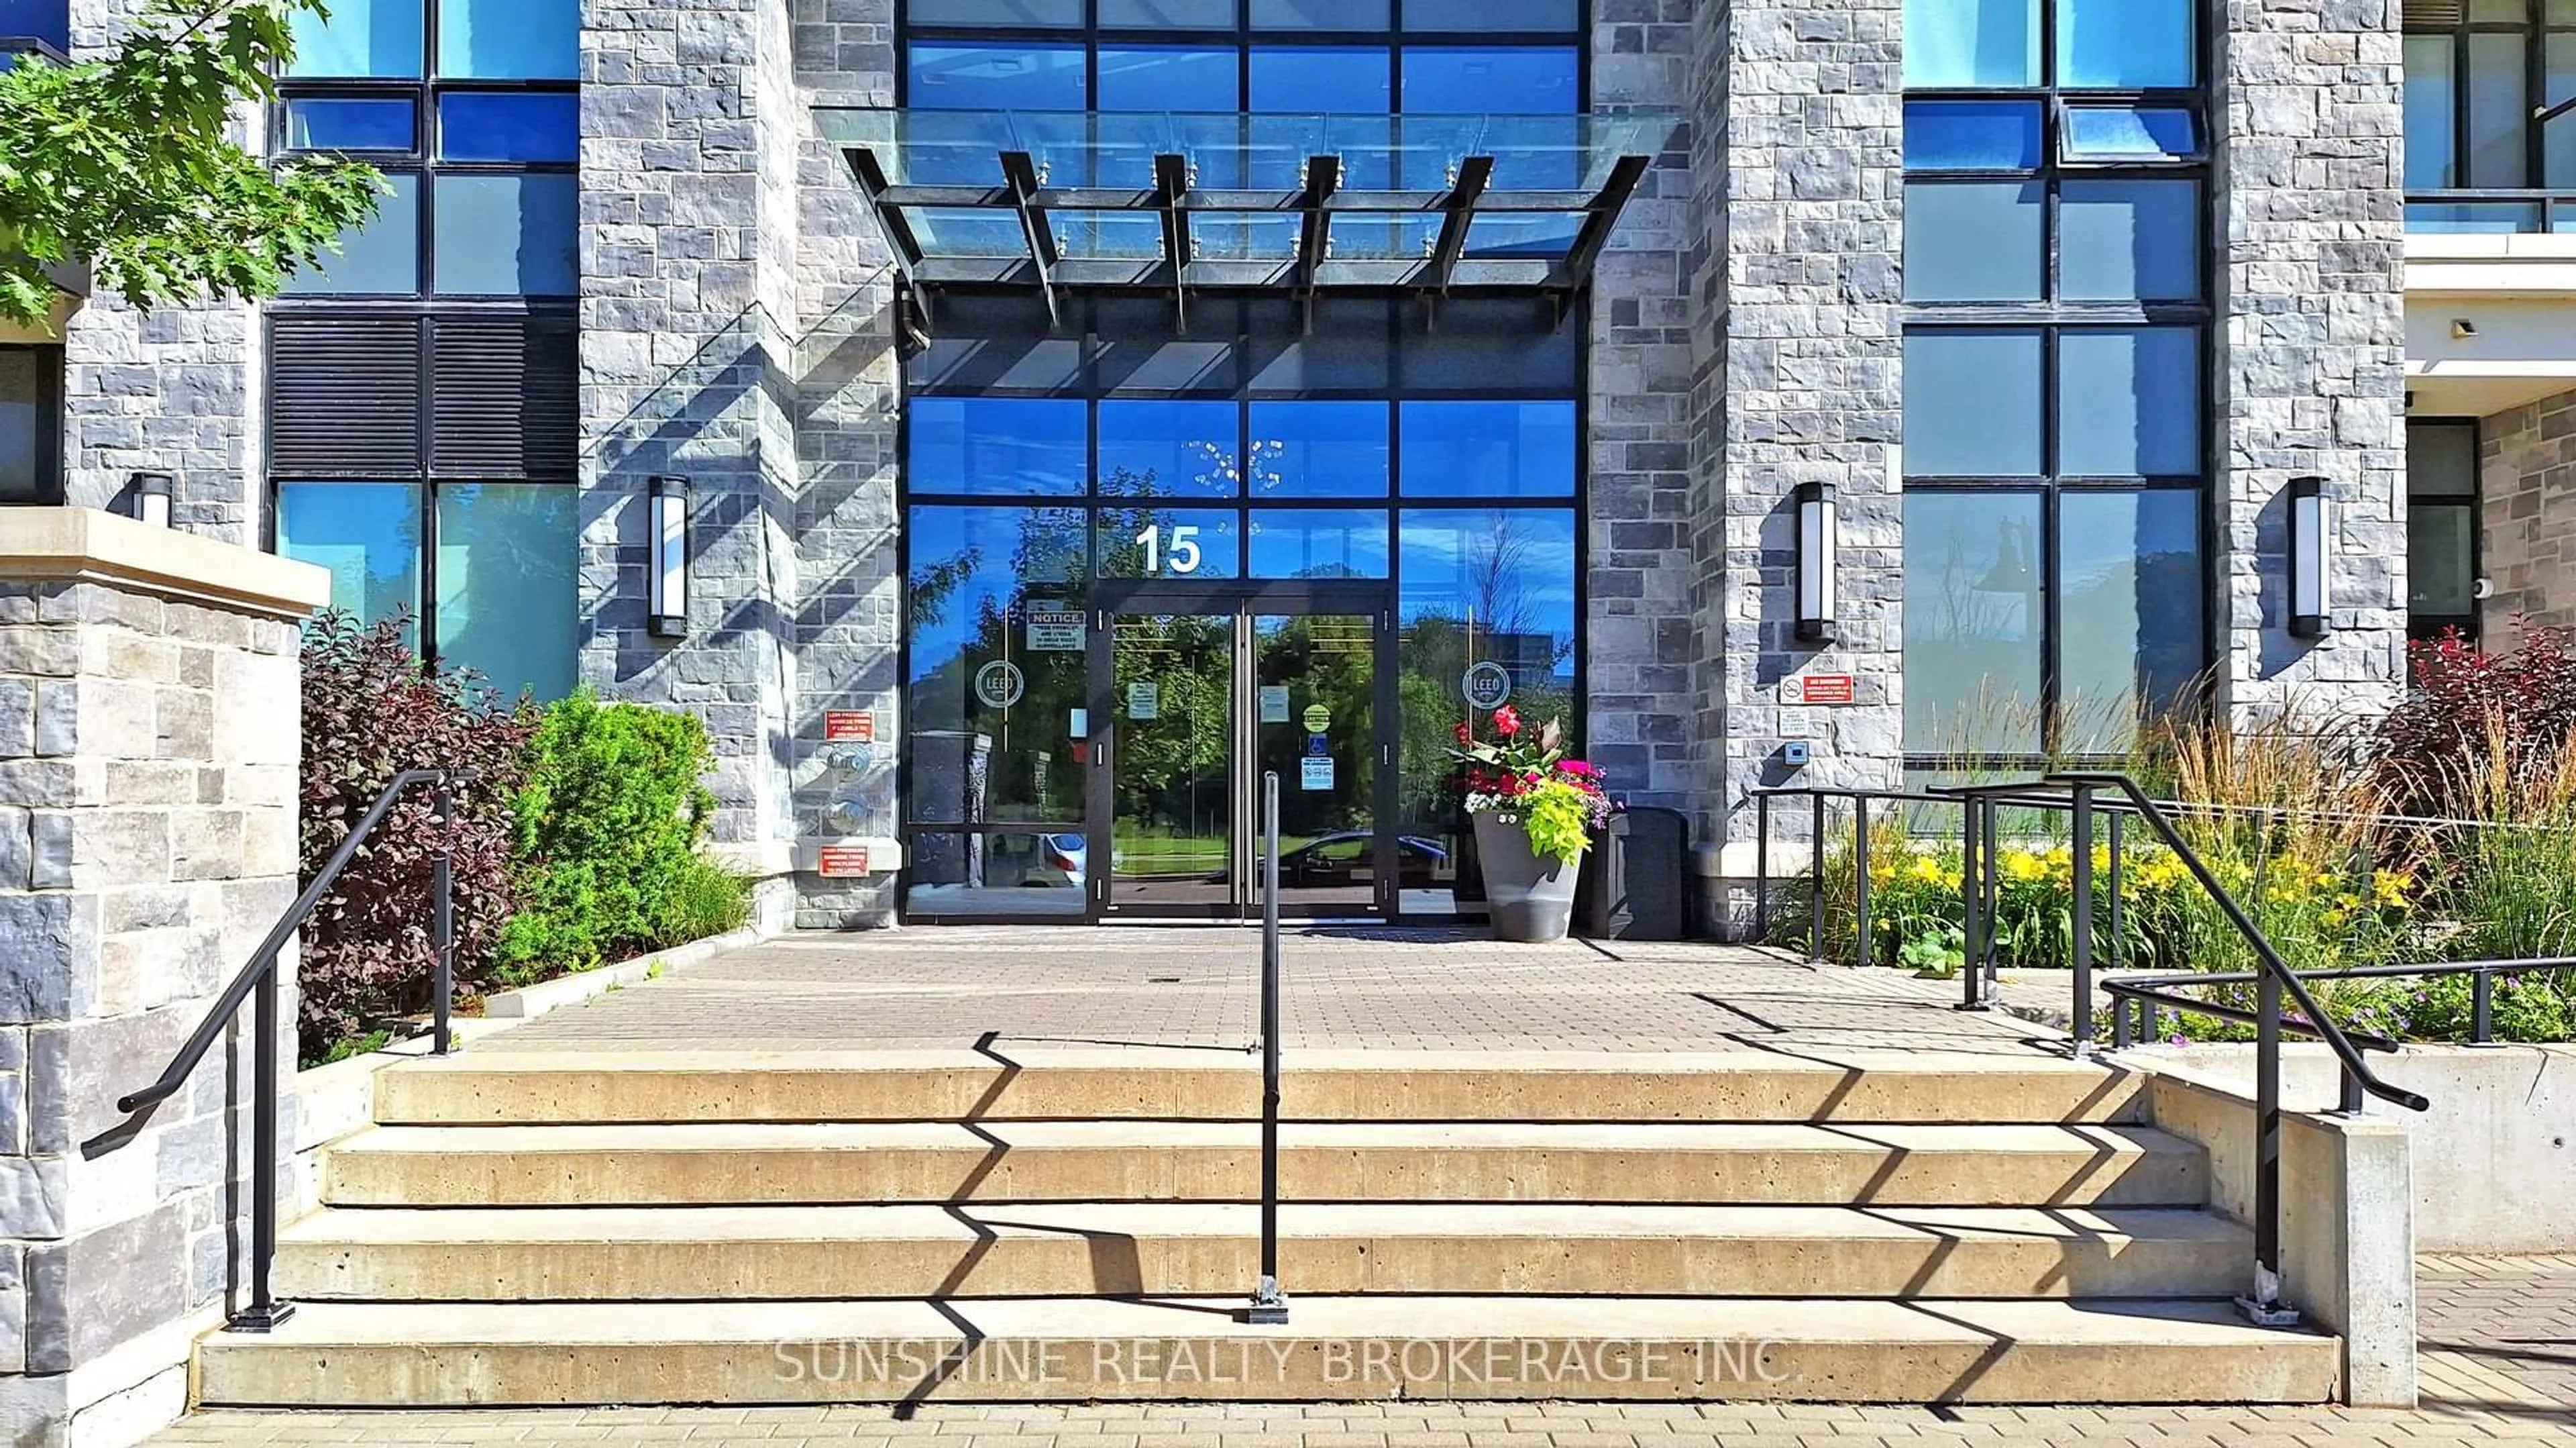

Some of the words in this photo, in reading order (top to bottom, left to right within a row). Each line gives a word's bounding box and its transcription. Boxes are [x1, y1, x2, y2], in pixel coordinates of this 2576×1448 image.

[1136, 525, 1201, 573] 15
[1033, 613, 1081, 623] NOTICE
[986, 676, 1013, 690] LEED
[1473, 678, 1500, 691] LEED
